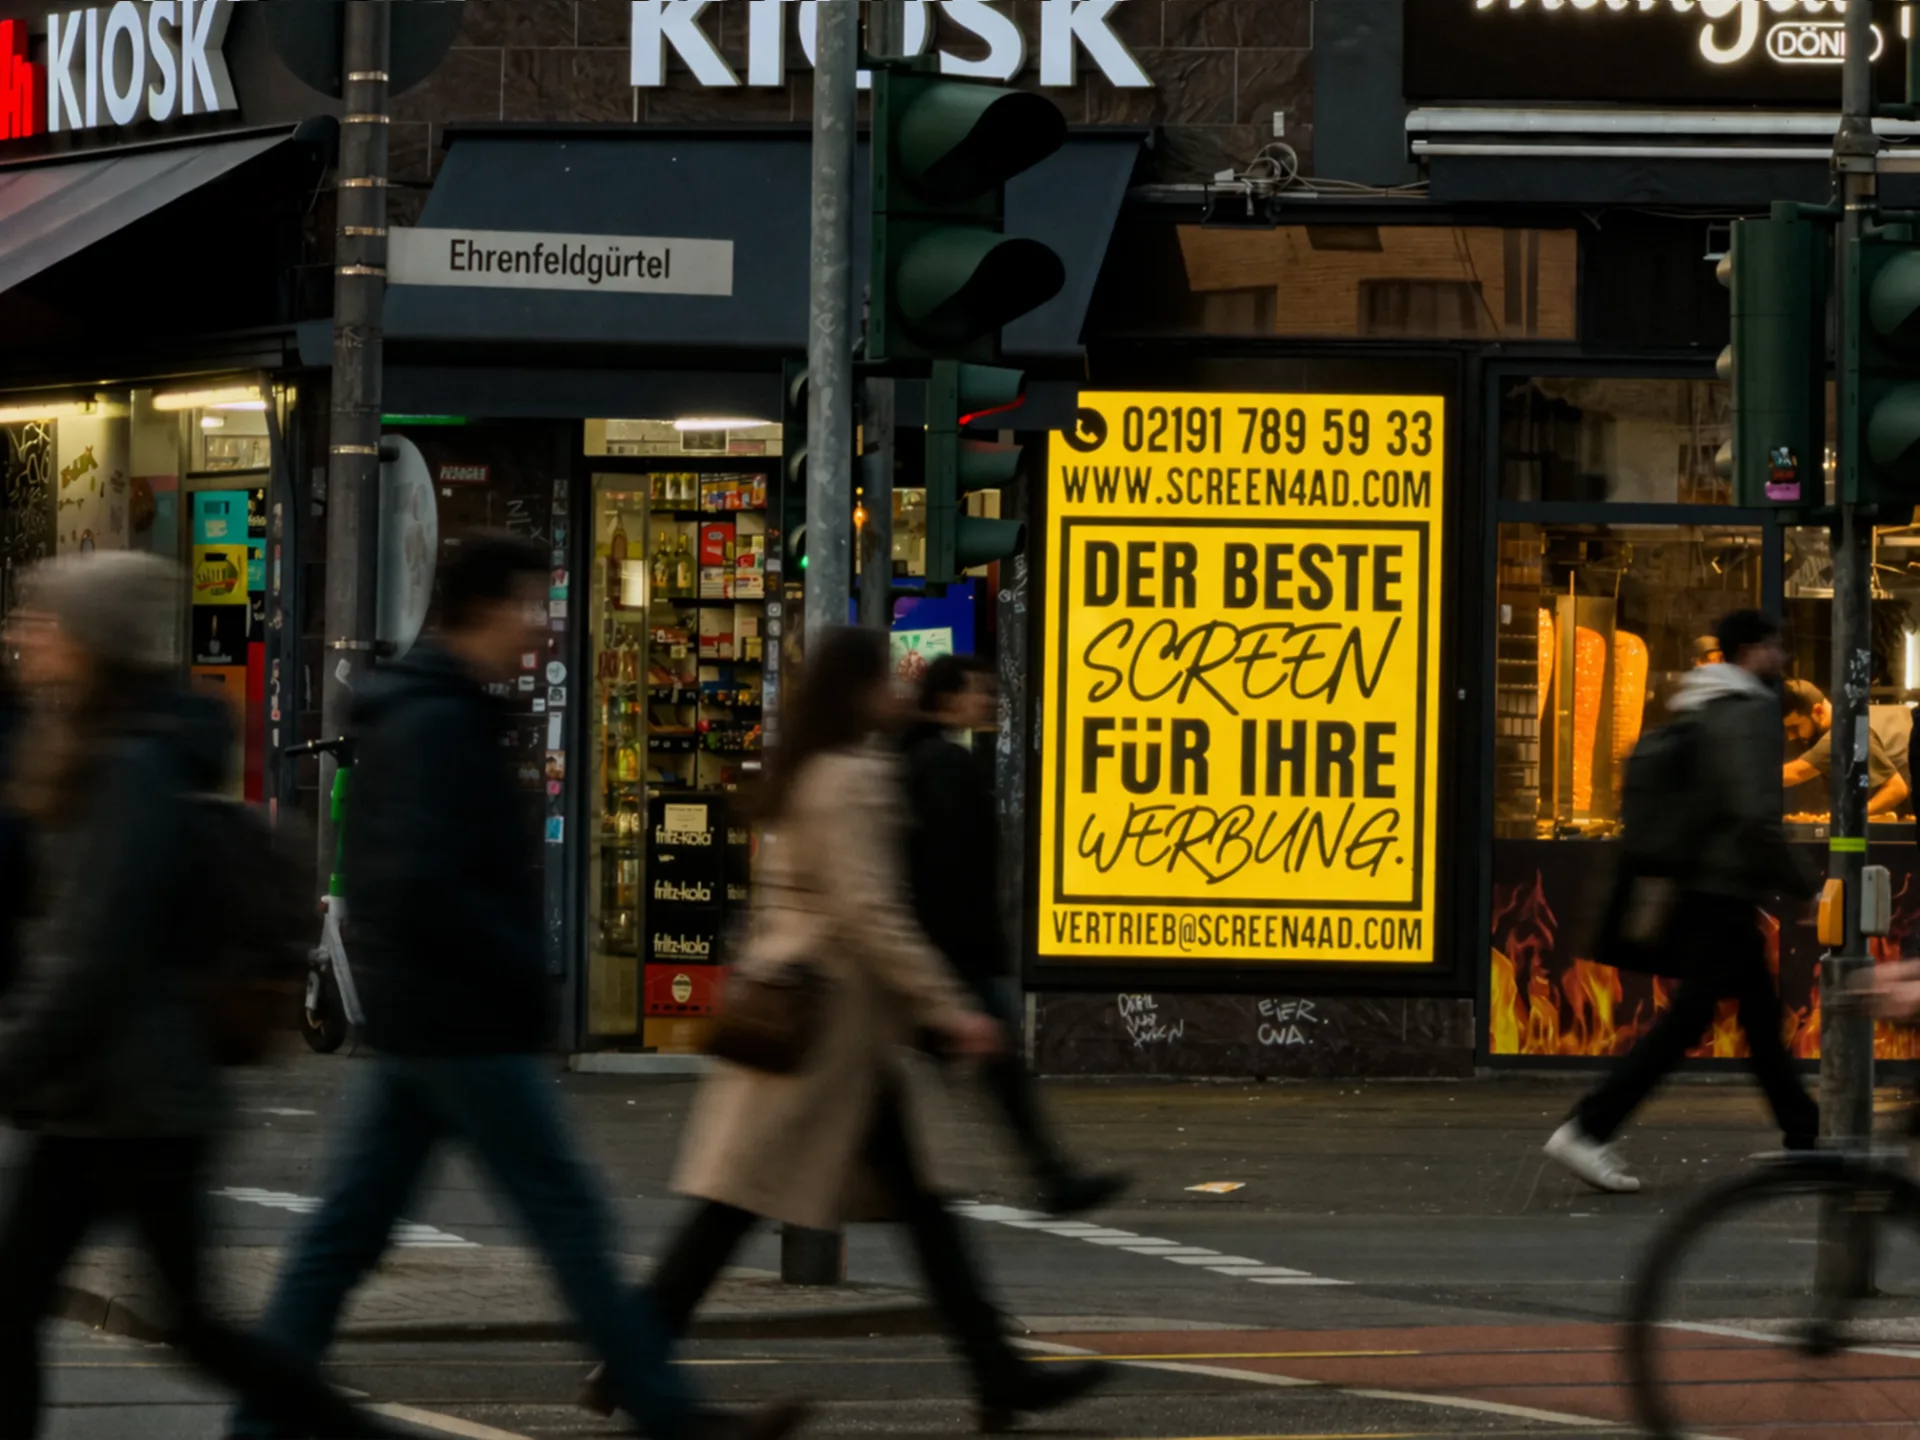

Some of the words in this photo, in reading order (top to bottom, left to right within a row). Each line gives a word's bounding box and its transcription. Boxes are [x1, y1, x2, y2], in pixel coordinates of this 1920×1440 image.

[47, 0, 224, 132] KIOSK
[450, 239, 670, 284] Ehrenfeldgürtel
[1122, 405, 1222, 453] 02191
[1237, 407, 1306, 455] 789
[1322, 408, 1370, 456] 59
[1386, 409, 1433, 457] 33
[1061, 465, 1432, 509] WWW.SCREEN4AD.COM
[1083, 540, 1198, 609] DER
[1223, 542, 1403, 612] BESTE
[1083, 616, 1402, 716] SCREEN
[1082, 716, 1211, 795] FÜR
[1240, 718, 1397, 799] IHRE
[1078, 802, 1404, 885] WERBUNG.
[654, 879, 711, 901] fritz-kola
[653, 932, 710, 955] fritz-kola
[1053, 910, 1423, 953] VERTRIEB@SCREEN4AD.COM
